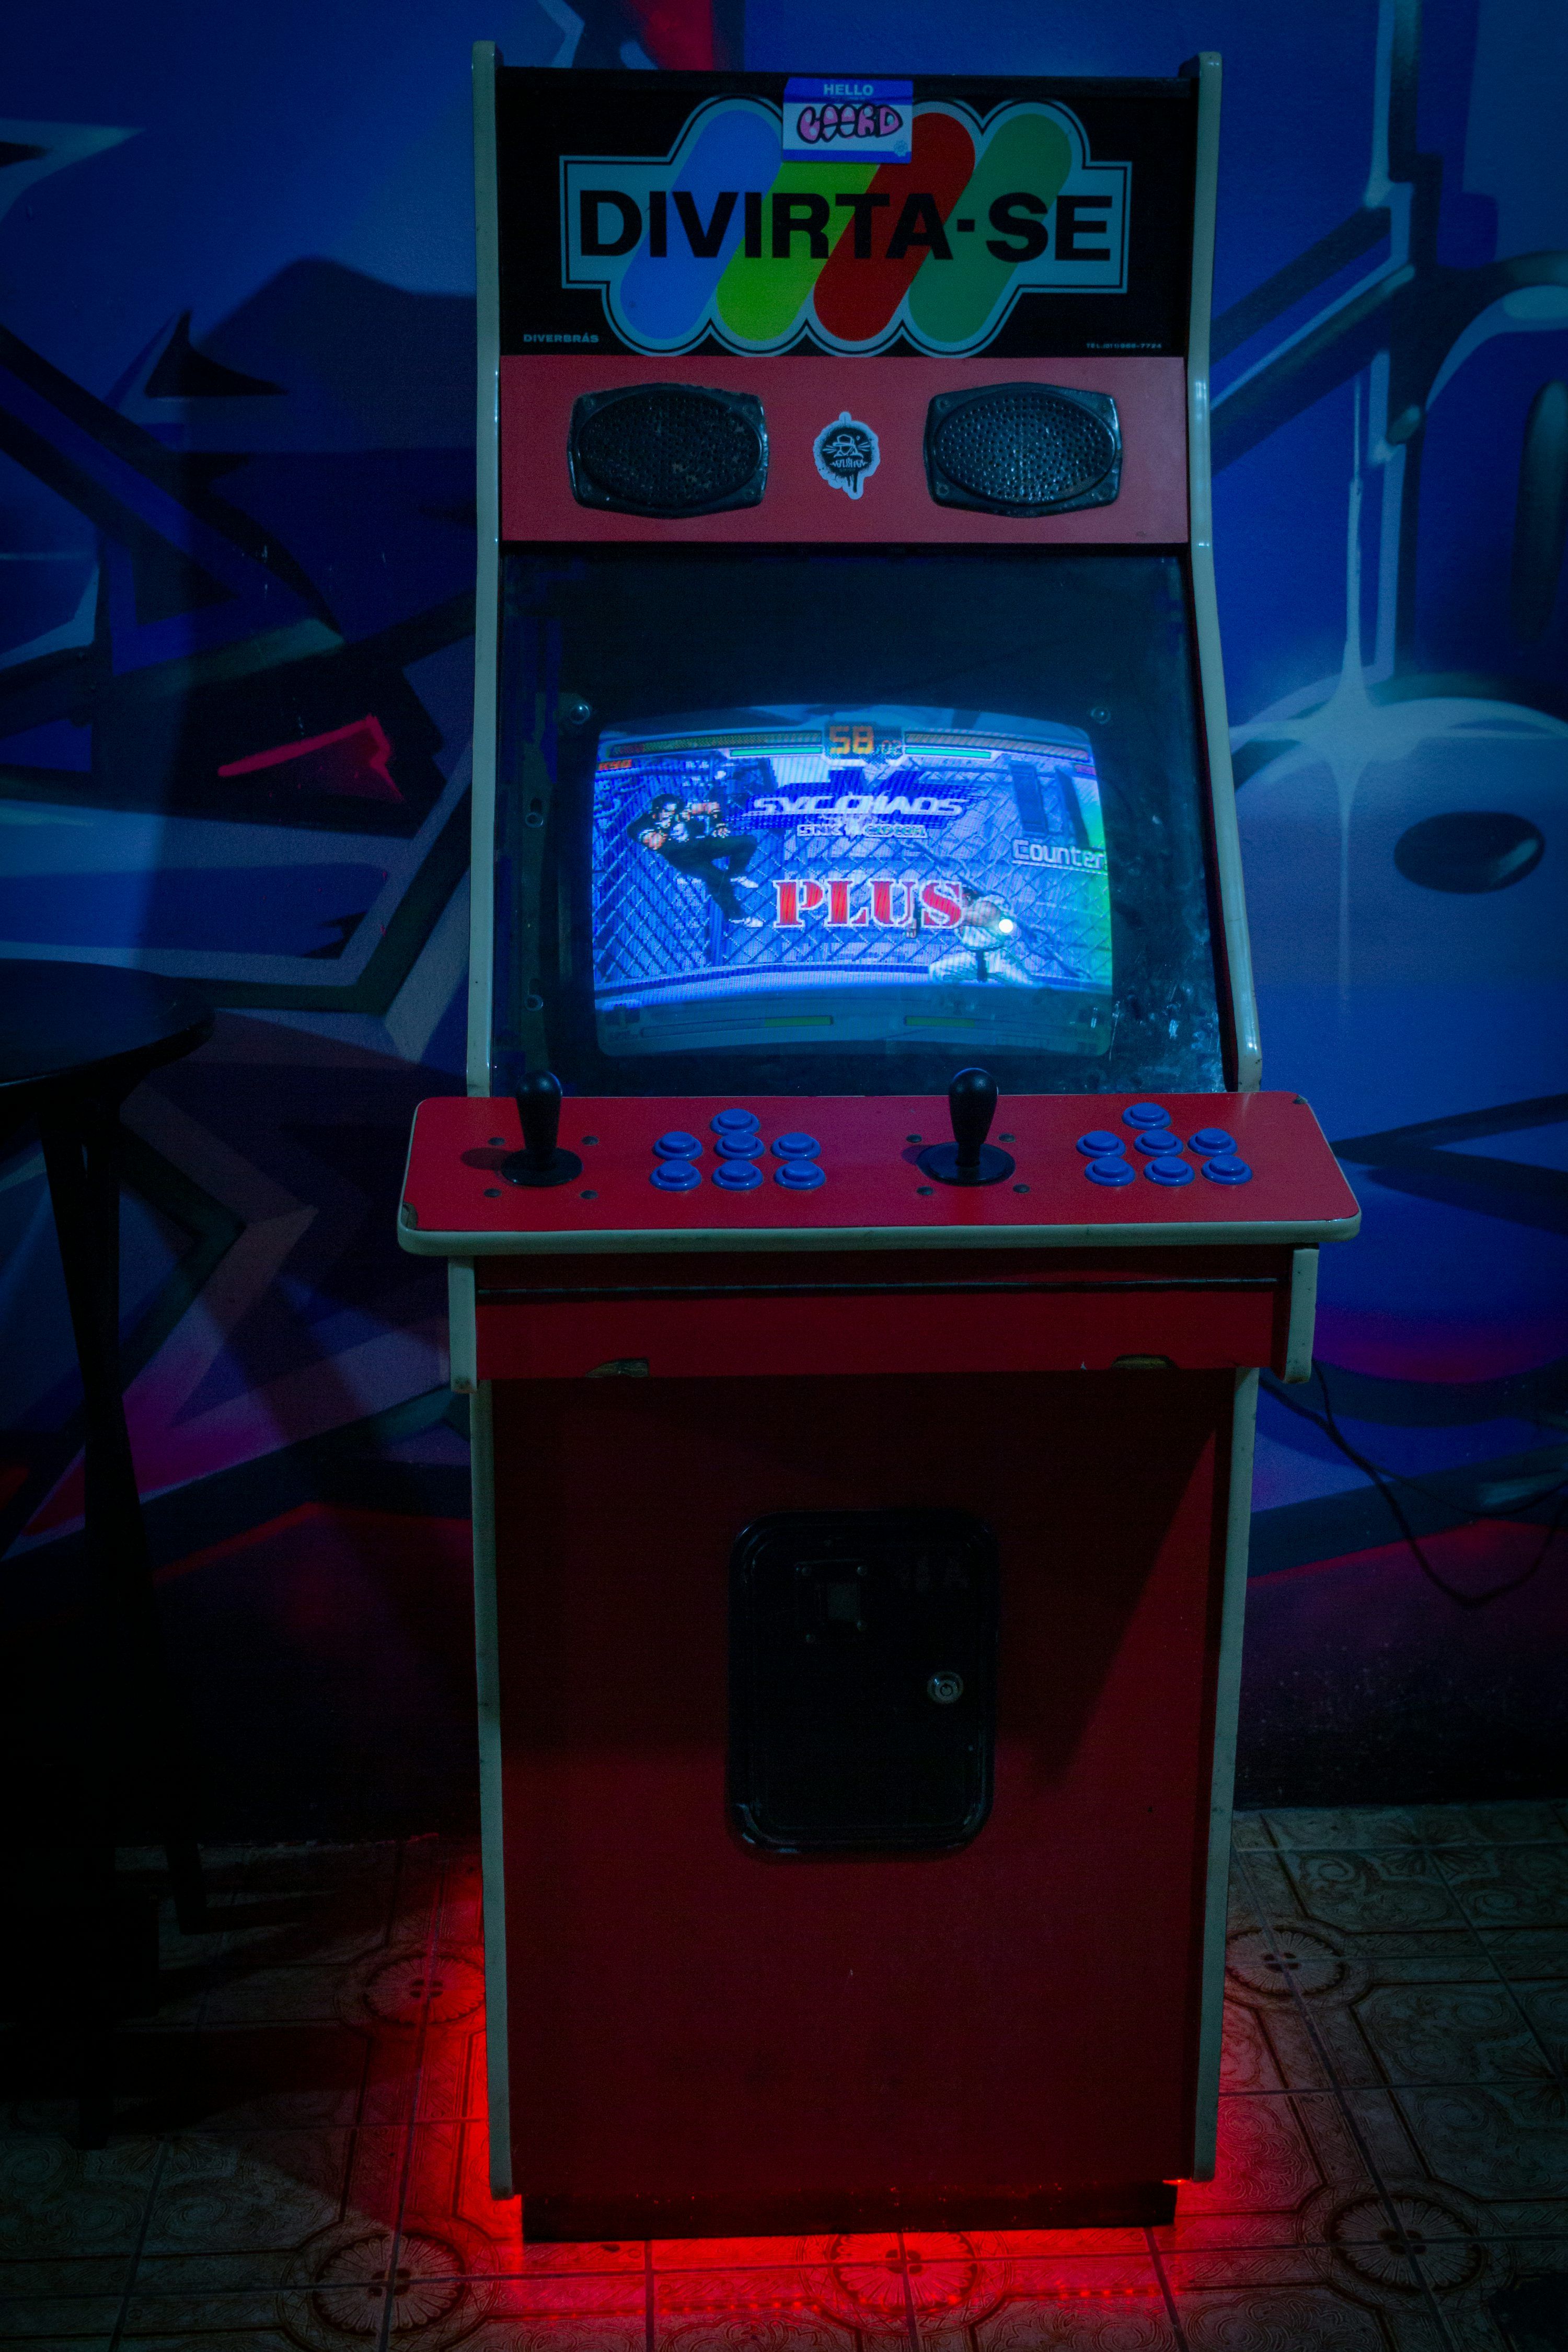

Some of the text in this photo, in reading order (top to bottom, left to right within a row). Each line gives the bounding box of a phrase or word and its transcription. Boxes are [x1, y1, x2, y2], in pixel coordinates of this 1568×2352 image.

[823, 84, 874, 96] HELLO
[580, 190, 1112, 262] DIVIRTA-SE
[523, 332, 599, 343] DIVERBRÁS
[829, 725, 874, 755] 58
[772, 878, 964, 929] PLUS
